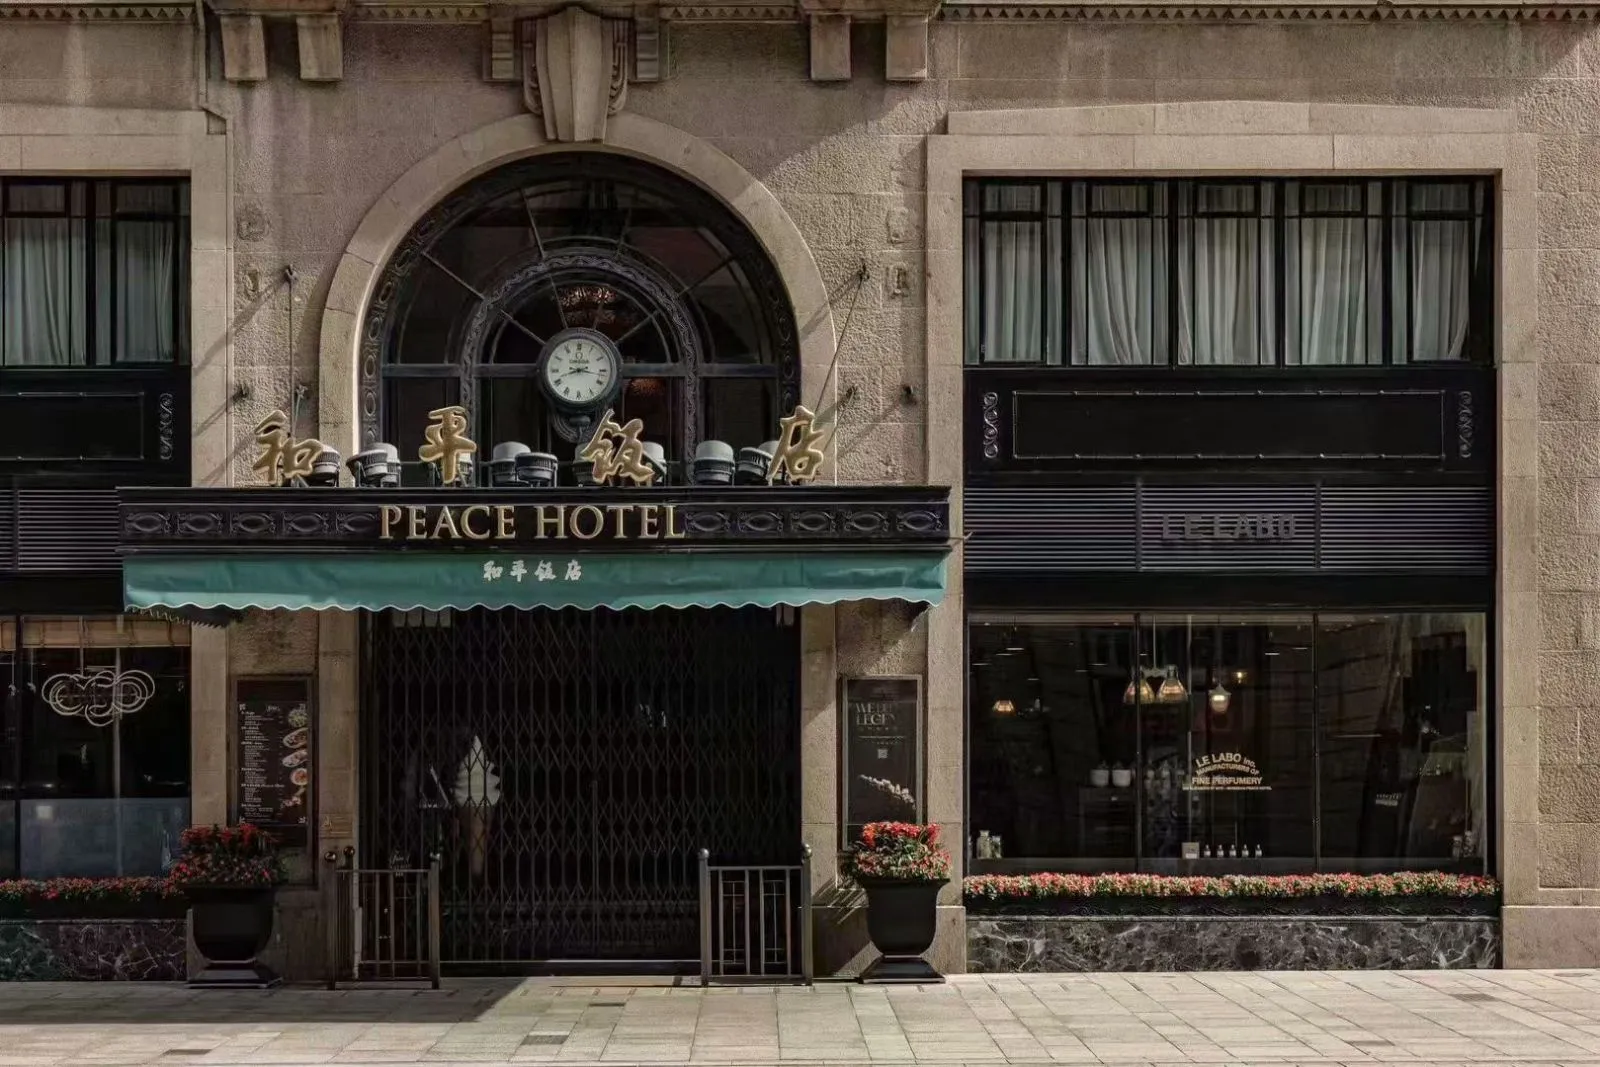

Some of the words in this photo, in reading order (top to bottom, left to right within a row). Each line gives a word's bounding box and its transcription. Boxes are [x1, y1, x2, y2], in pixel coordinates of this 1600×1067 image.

[378, 504, 517, 540] PEACE
[533, 504, 686, 540] HOTEL
[1162, 514, 1202, 539] LE
[1213, 513, 1296, 539] LABO
[1195, 755, 1211, 768] LE
[1212, 752, 1242, 763] LABO
[1195, 763, 1250, 776] MANUFACTURERS
[1191, 777, 1211, 785] FINE
[1212, 777, 1263, 785] PERFUMERY
